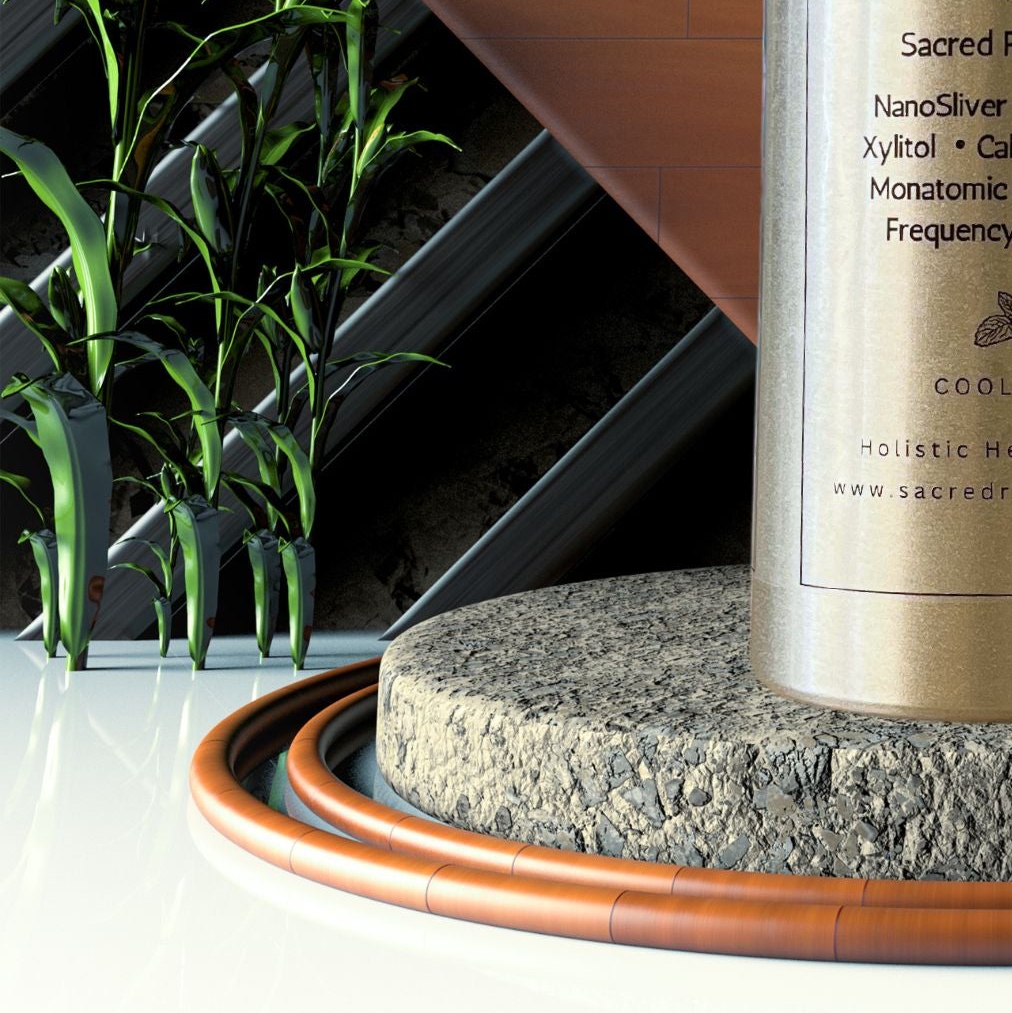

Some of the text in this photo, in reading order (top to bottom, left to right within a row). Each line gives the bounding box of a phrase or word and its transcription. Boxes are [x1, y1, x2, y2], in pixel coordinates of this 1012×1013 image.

[901, 30, 993, 57] Sacred
[874, 92, 1007, 118] NanoSliver
[862, 133, 936, 165] Xylitol
[870, 176, 1008, 200] Monatomic
[934, 377, 1012, 396] COOL
[861, 438, 969, 458] Holistic
